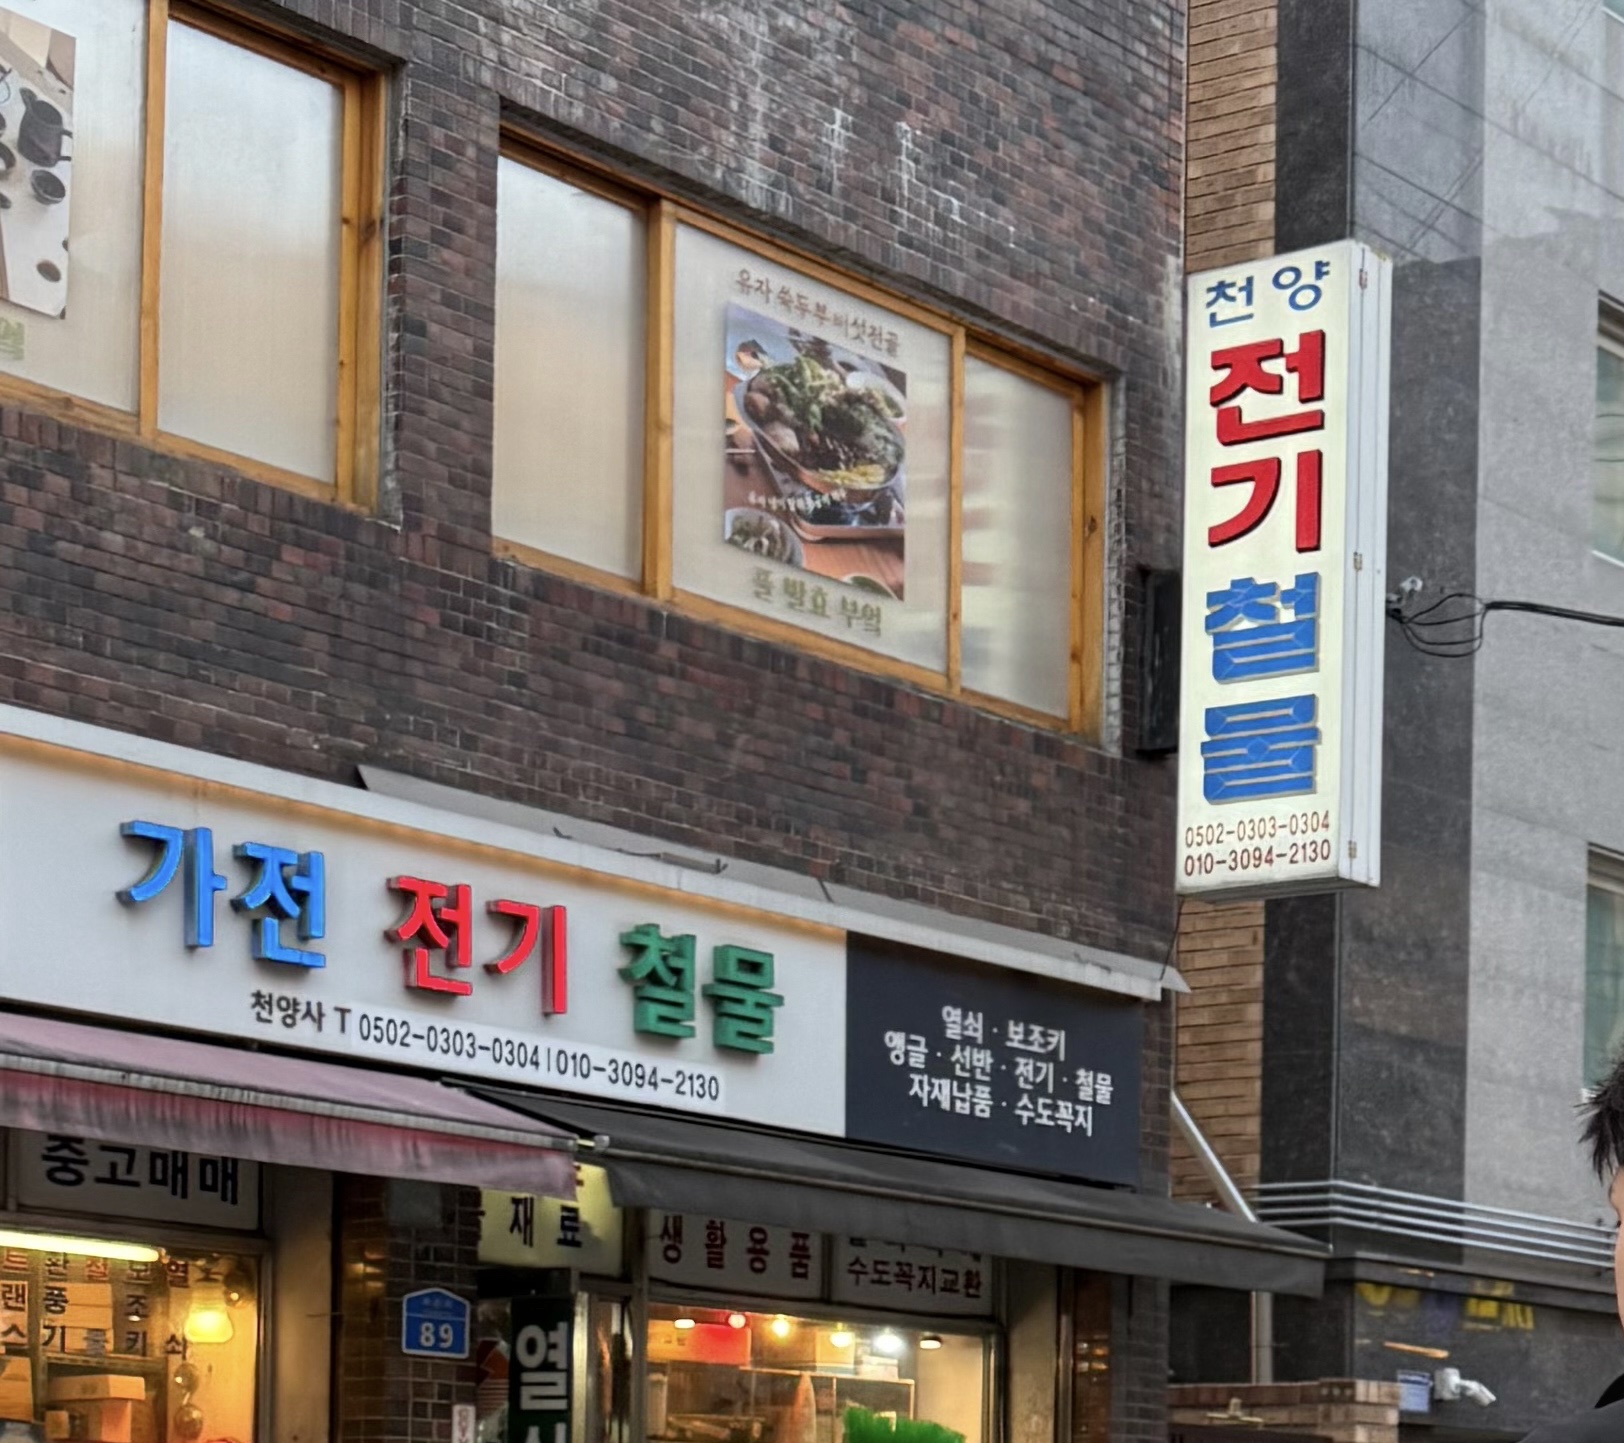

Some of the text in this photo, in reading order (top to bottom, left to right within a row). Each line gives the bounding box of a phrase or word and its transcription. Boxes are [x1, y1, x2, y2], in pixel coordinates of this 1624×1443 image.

[1206, 260, 1330, 328] 천양
[1208, 329, 1326, 554] 전기
[1201, 572, 1322, 806] 철물
[1184, 839, 1331, 877] 010-3094-2130
[1185, 810, 1330, 848] 0502-0303-0304
[116, 820, 785, 1055] 가전 전기 철물
[250, 989, 326, 1033] 천양사
[334, 1006, 352, 1035] T
[941, 1005, 1066, 1062] 열쇠 보조키
[884, 1030, 1114, 1105] 앵글 선반 전기 철물
[909, 1073, 1093, 1137] 자재납품 수도꼭지
[41, 1134, 239, 1205] 중고매매
[481, 1196, 583, 1248] 재료
[660, 1215, 811, 1280] 생활용품
[847, 1255, 983, 1299] 수도꼭지교환
[419, 1321, 454, 1349] 89
